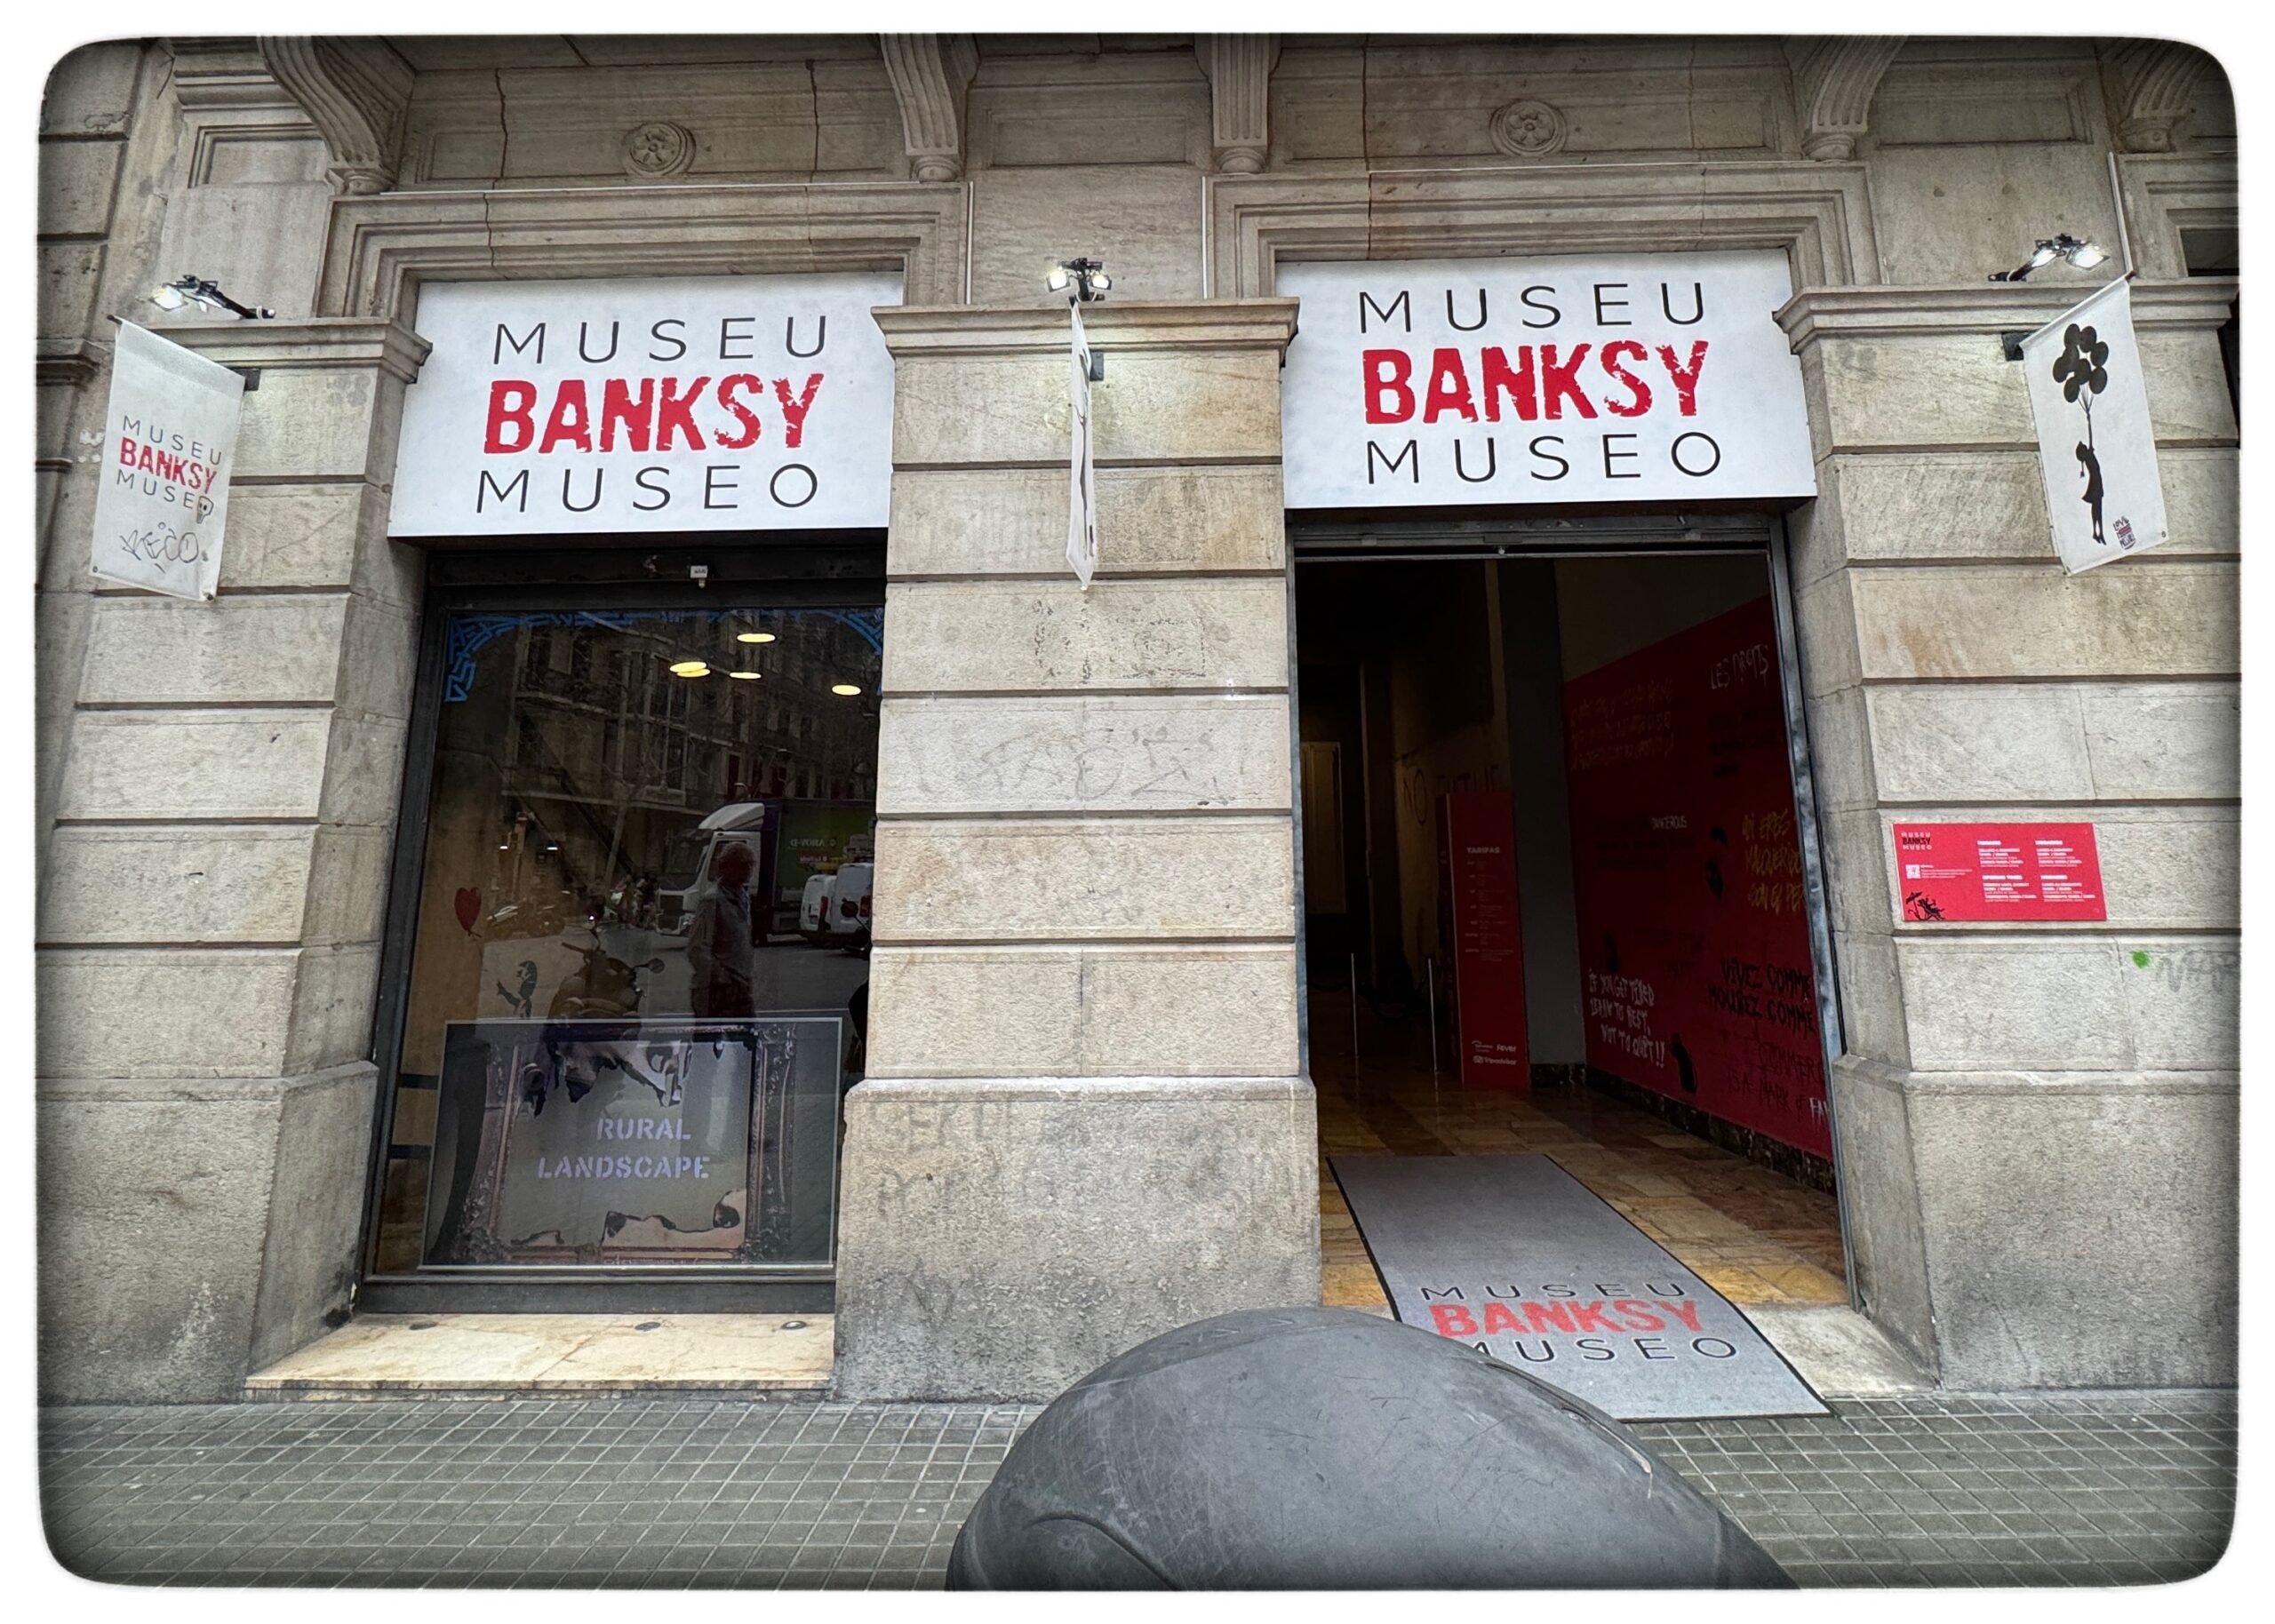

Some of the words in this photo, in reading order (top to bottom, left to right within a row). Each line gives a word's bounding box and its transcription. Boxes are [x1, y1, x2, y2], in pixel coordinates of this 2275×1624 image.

[1359, 283, 1704, 333] MUSEU
[493, 315, 826, 365] MUSEU
[1361, 339, 1709, 425] BANKSY
[483, 373, 825, 454] BANKSY
[119, 436, 217, 494] BANKSY
[123, 415, 221, 466] MUSEU
[1366, 431, 1721, 484] MUSEO
[116, 468, 213, 517] MUSE
[476, 463, 818, 513] MUSEO
[1721, 957, 1762, 990] VIVEZ
[1766, 962, 1812, 1000] COMME
[1618, 1030, 1631, 1053] TO
[1767, 999, 1817, 1039] COMME
[596, 1118, 692, 1141] RURAL
[538, 1156, 710, 1179] LANDSCAPE
[1420, 1283, 1685, 1301] MUSEU
[1429, 1300, 1704, 1339] BANKSY
